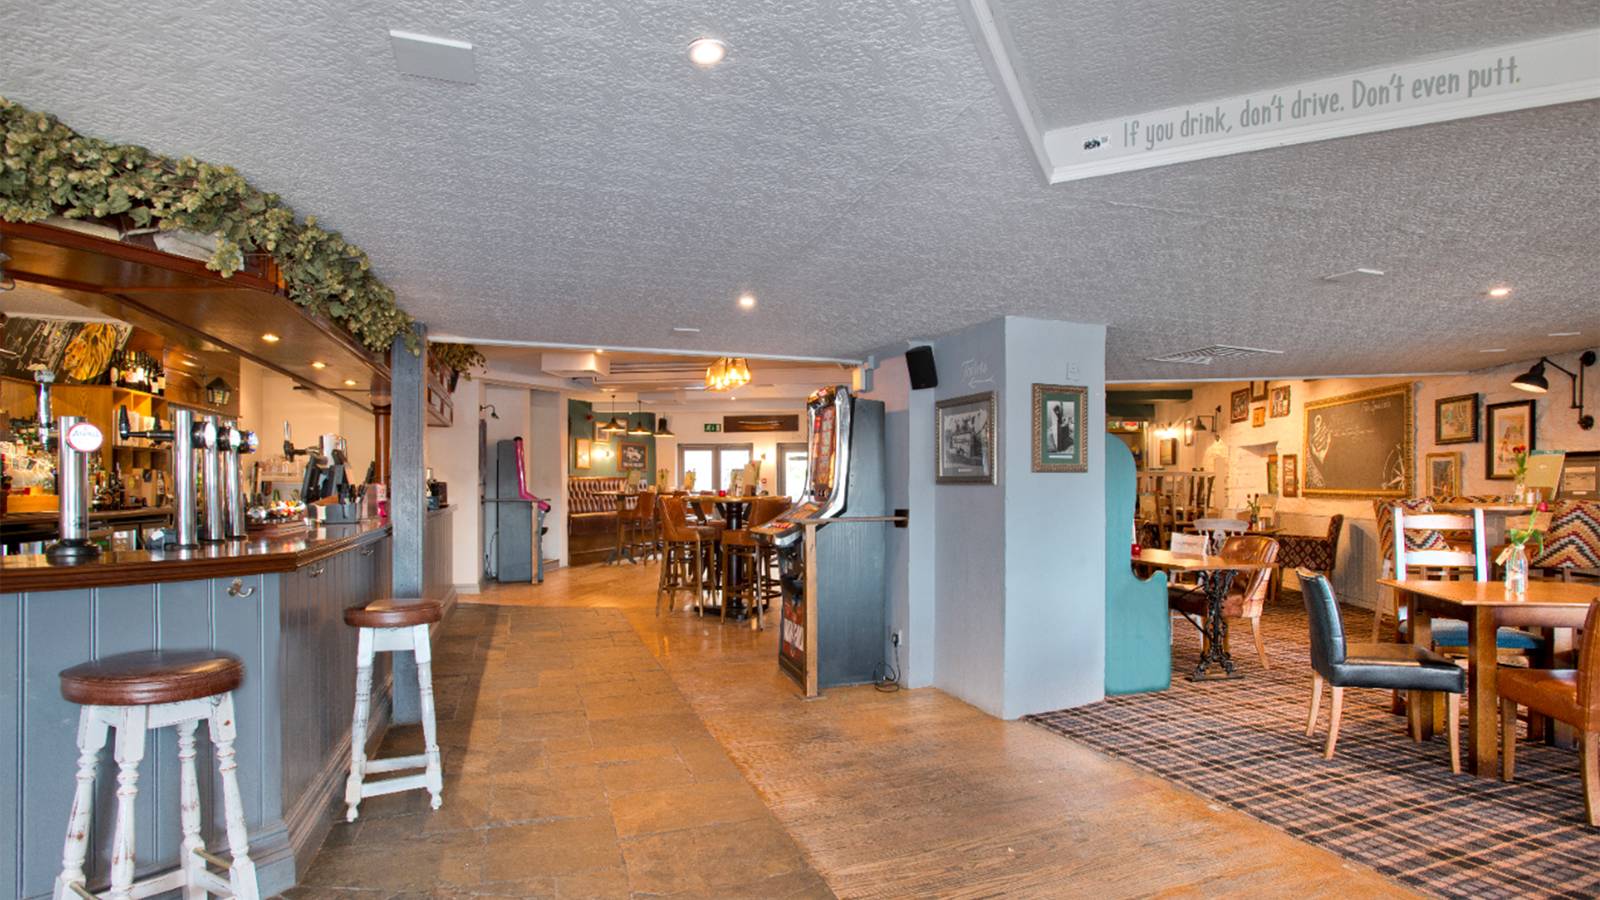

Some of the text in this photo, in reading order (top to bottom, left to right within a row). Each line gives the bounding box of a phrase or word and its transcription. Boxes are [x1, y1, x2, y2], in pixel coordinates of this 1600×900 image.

[1123, 119, 1140, 148] If
[1145, 121, 1174, 151] you
[1179, 109, 1233, 138] drink,
[1239, 93, 1285, 128] don't
[1290, 89, 1345, 120] drive.
[1351, 72, 1405, 110] Don't
[1411, 72, 1461, 100] even
[1467, 55, 1521, 98] putt.
